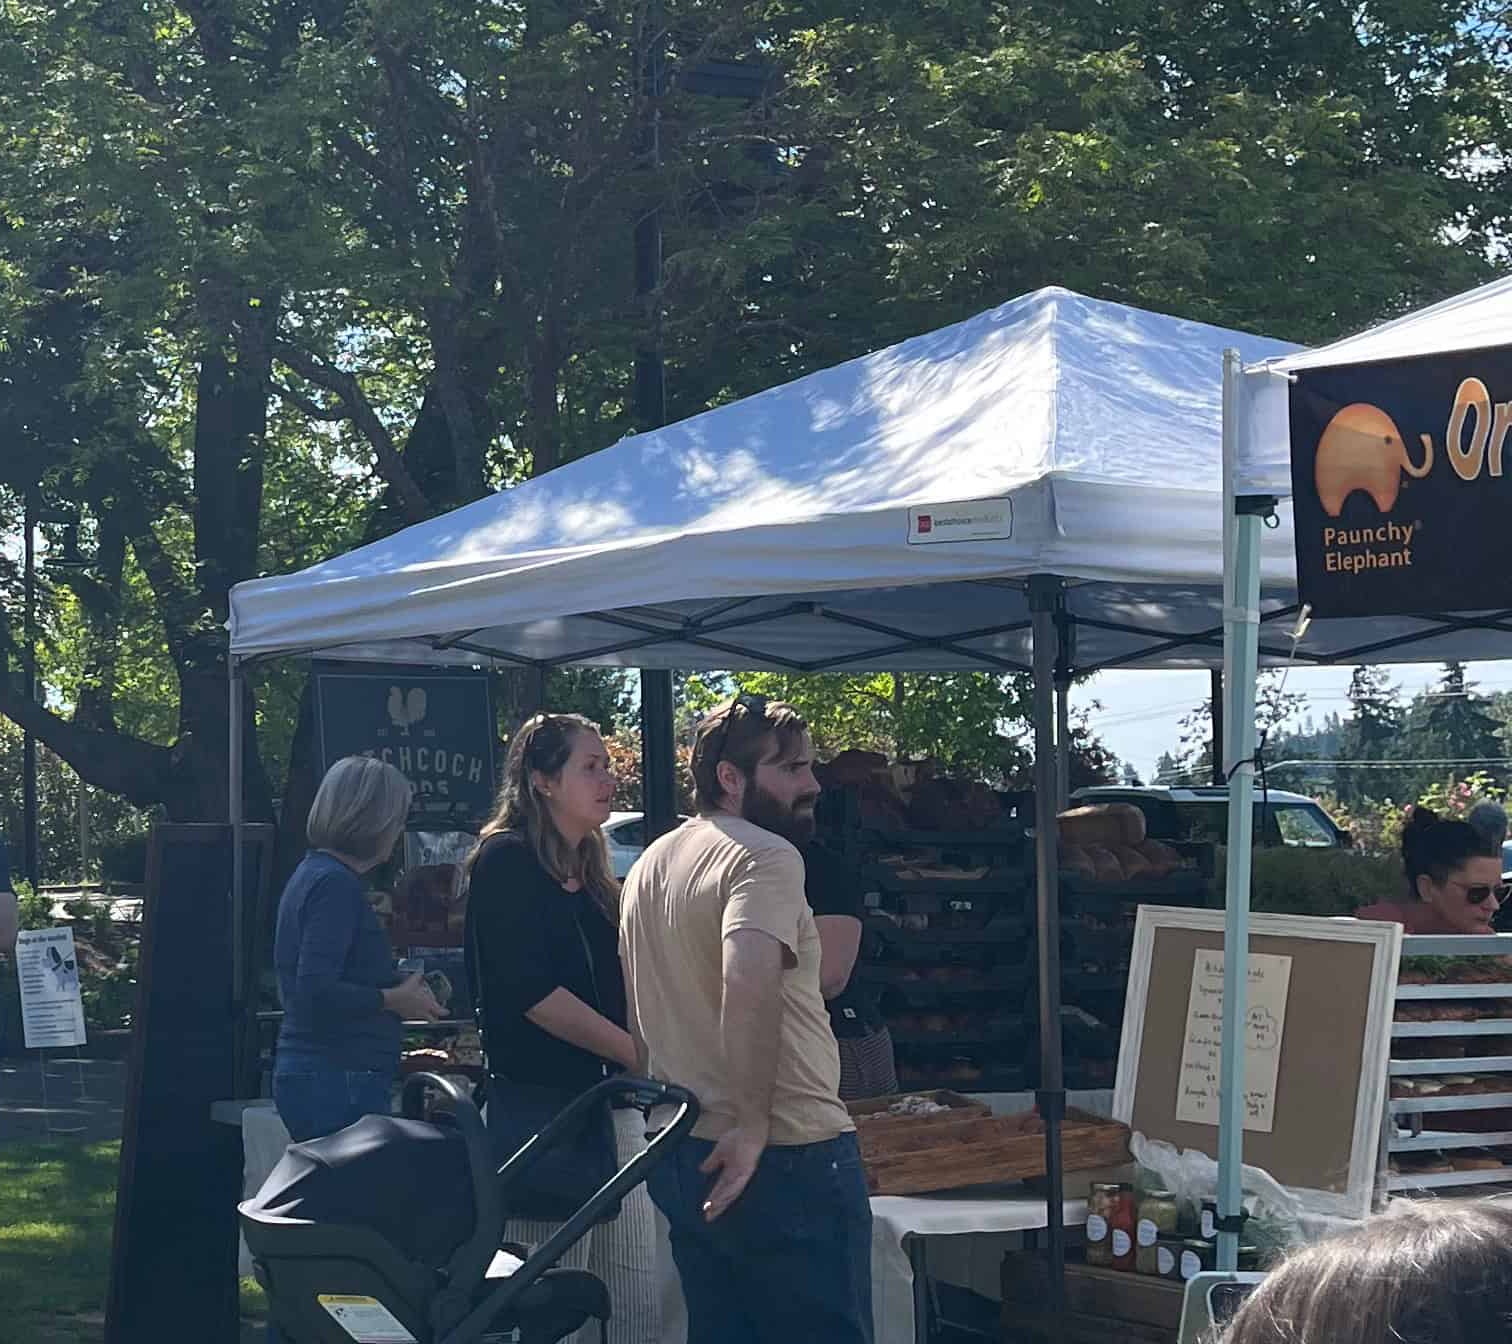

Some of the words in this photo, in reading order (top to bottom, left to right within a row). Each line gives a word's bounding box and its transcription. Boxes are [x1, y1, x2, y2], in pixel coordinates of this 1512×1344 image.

[1324, 521, 1414, 547] Paunchy
[1325, 548, 1413, 575] Elephant
[361, 746, 483, 784] CHCOCK
